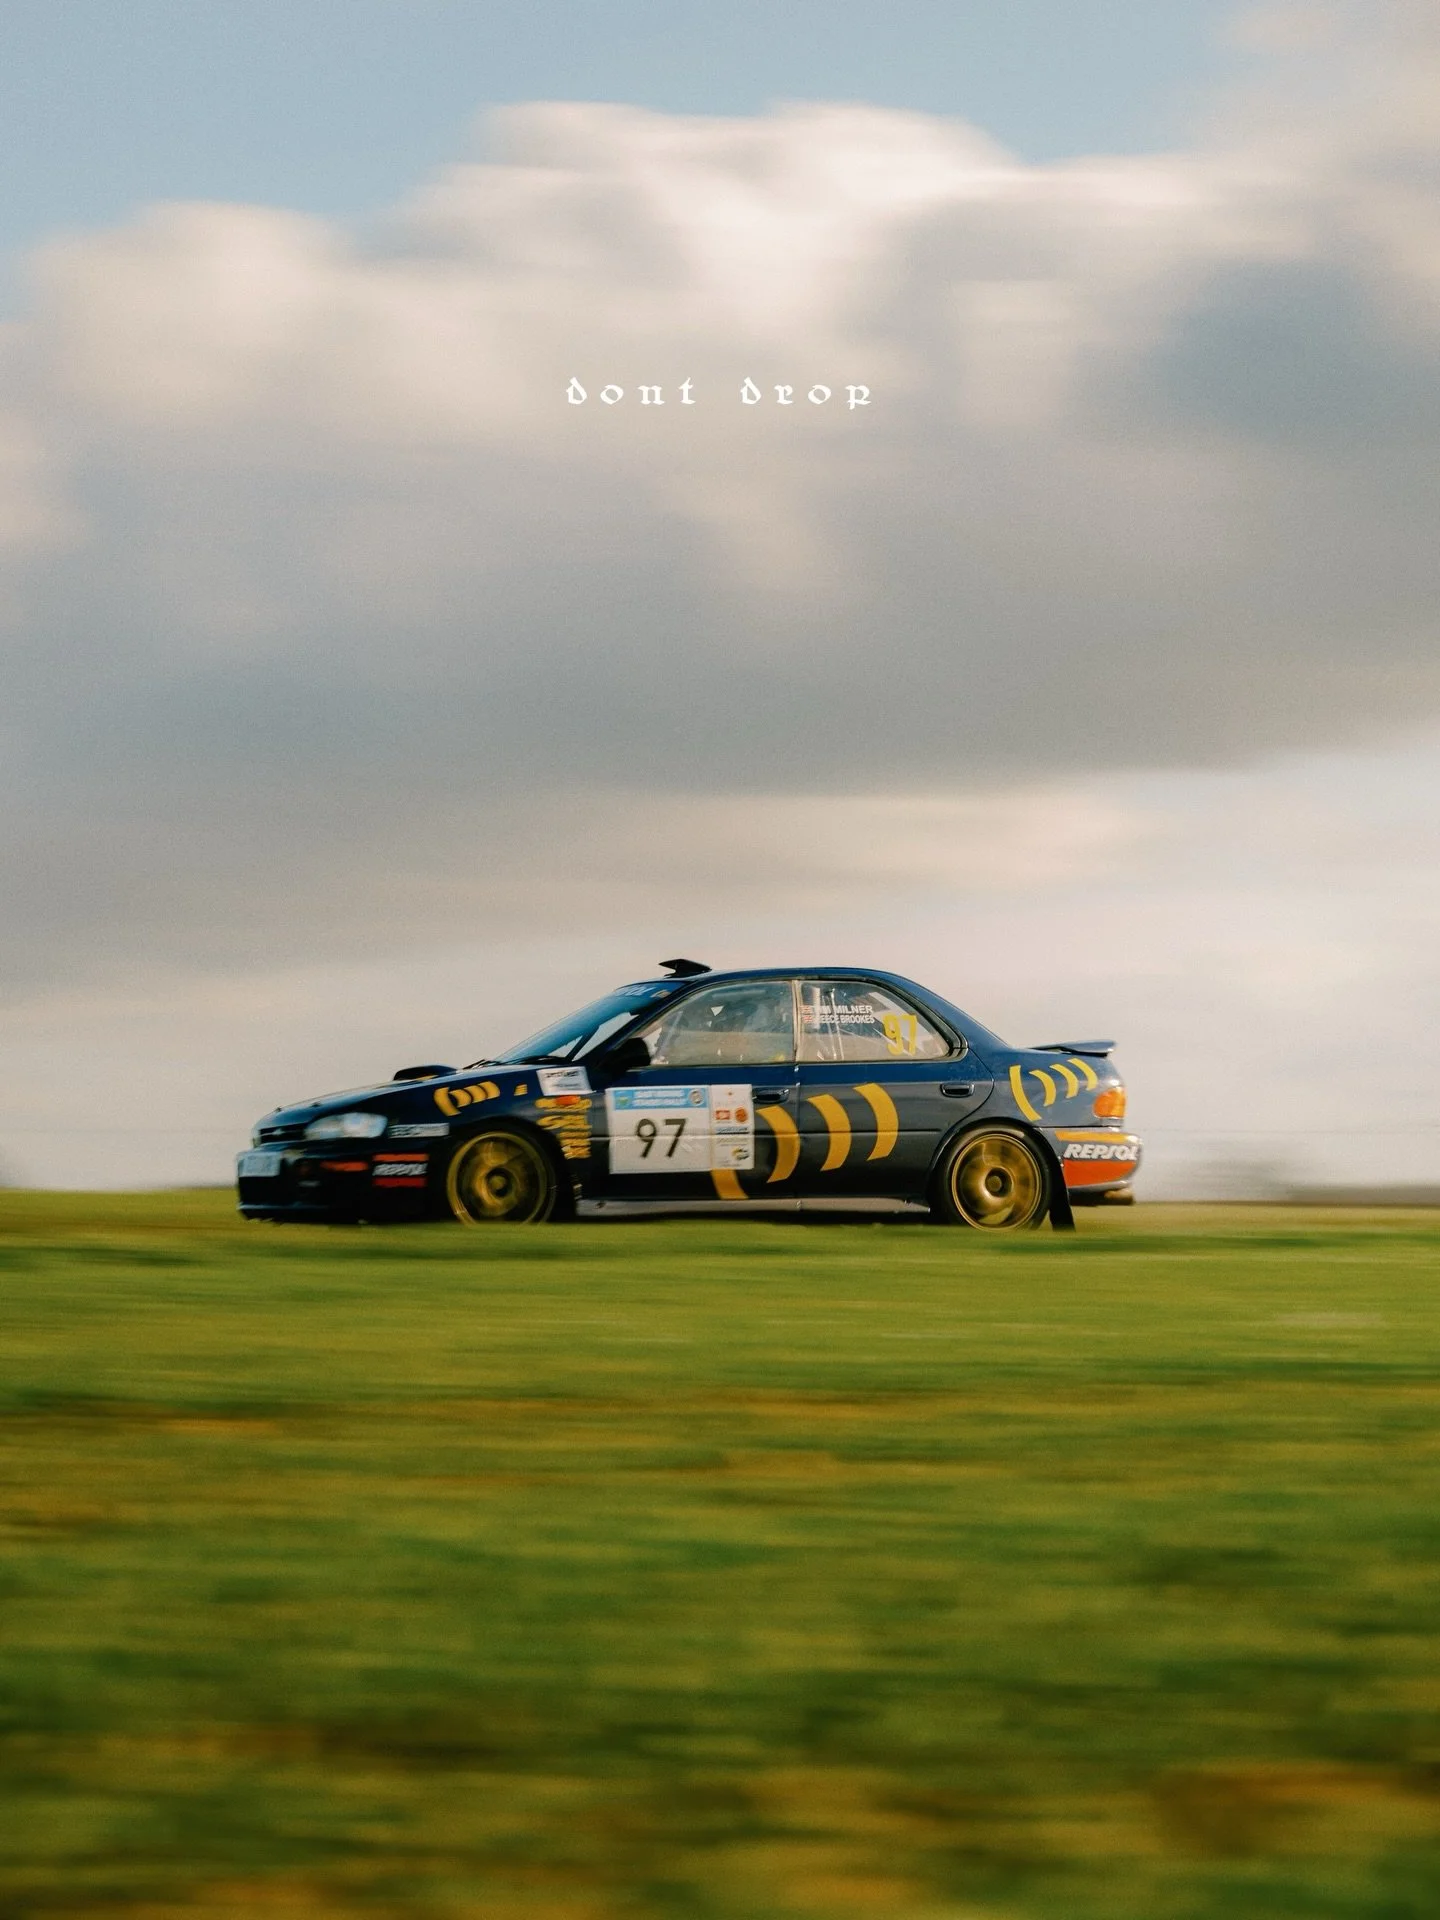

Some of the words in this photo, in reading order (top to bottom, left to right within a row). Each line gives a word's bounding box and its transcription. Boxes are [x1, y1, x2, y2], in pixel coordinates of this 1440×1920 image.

[835, 1005, 873, 1014] MILNER
[813, 1015, 840, 1024] EECE
[882, 1013, 917, 1056] 97
[636, 1118, 687, 1158] 97
[1063, 1143, 1138, 1161] REPSOL
